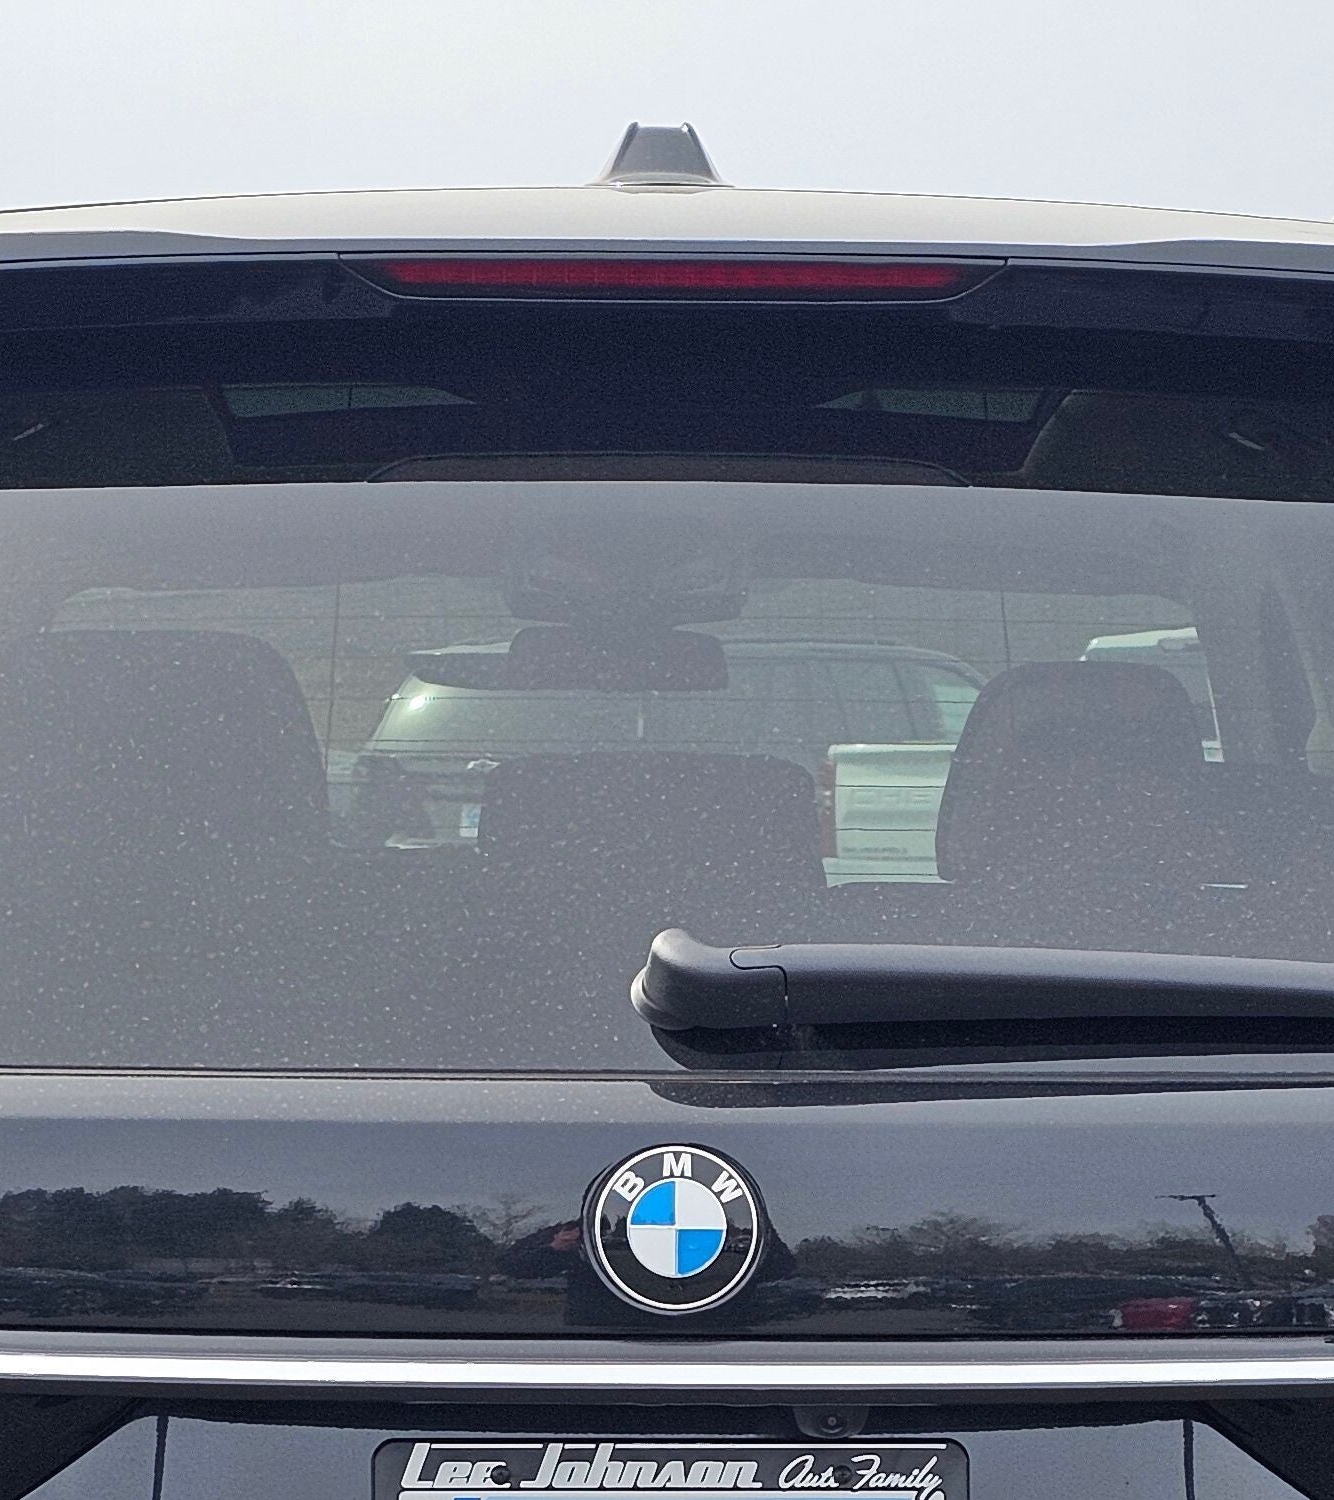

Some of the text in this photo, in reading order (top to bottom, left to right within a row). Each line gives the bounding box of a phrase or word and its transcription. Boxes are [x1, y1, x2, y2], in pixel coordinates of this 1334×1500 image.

[612, 1152, 743, 1204] BMW
[400, 1442, 511, 1488] Lee
[520, 1442, 762, 1488] Johnson
[778, 1454, 842, 1489] Aut
